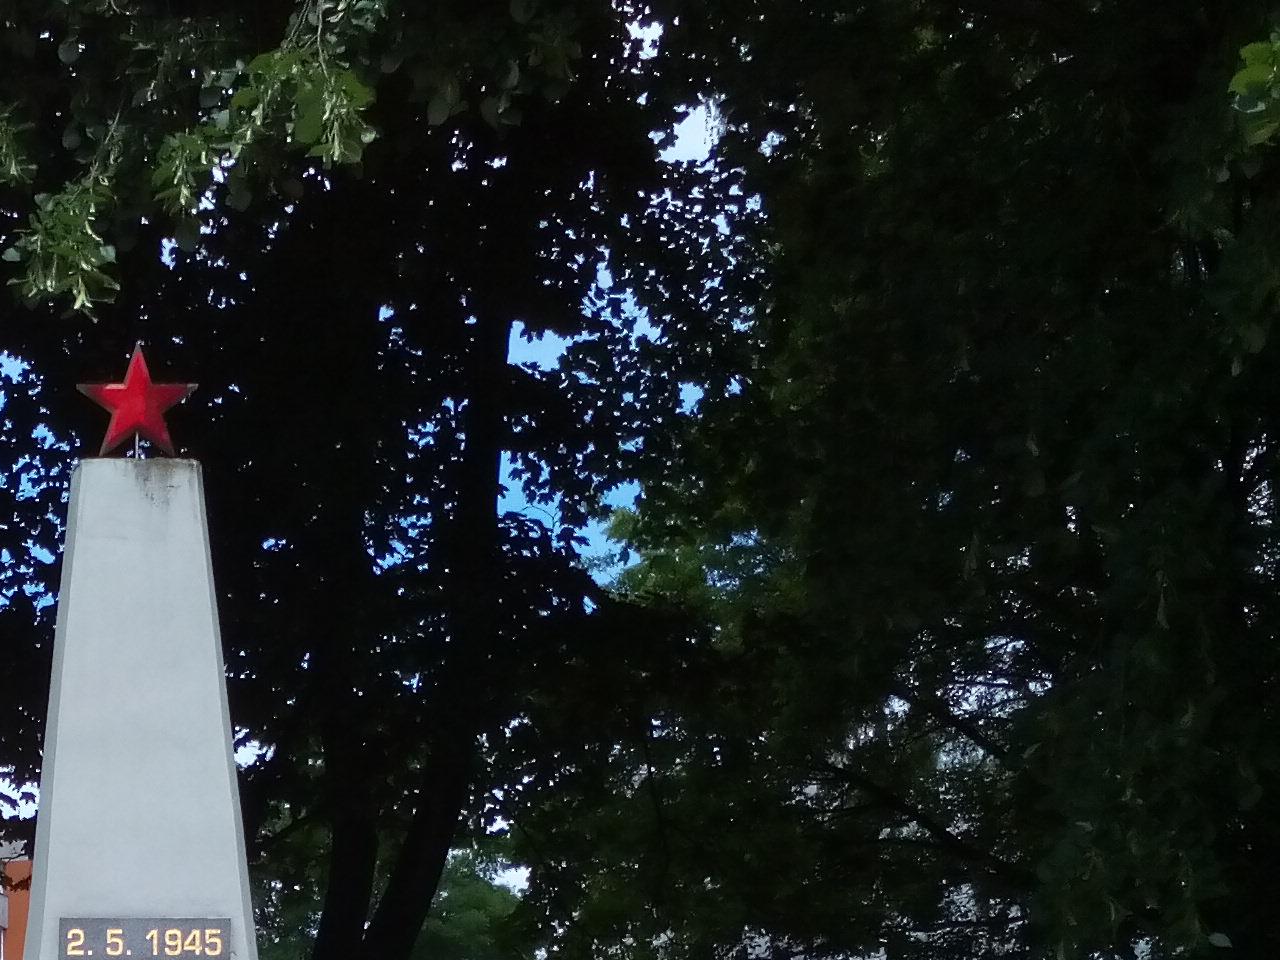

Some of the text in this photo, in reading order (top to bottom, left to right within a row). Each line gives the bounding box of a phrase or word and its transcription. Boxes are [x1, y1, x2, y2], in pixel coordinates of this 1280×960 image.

[66, 928, 222, 956] 2. 5. 1945
